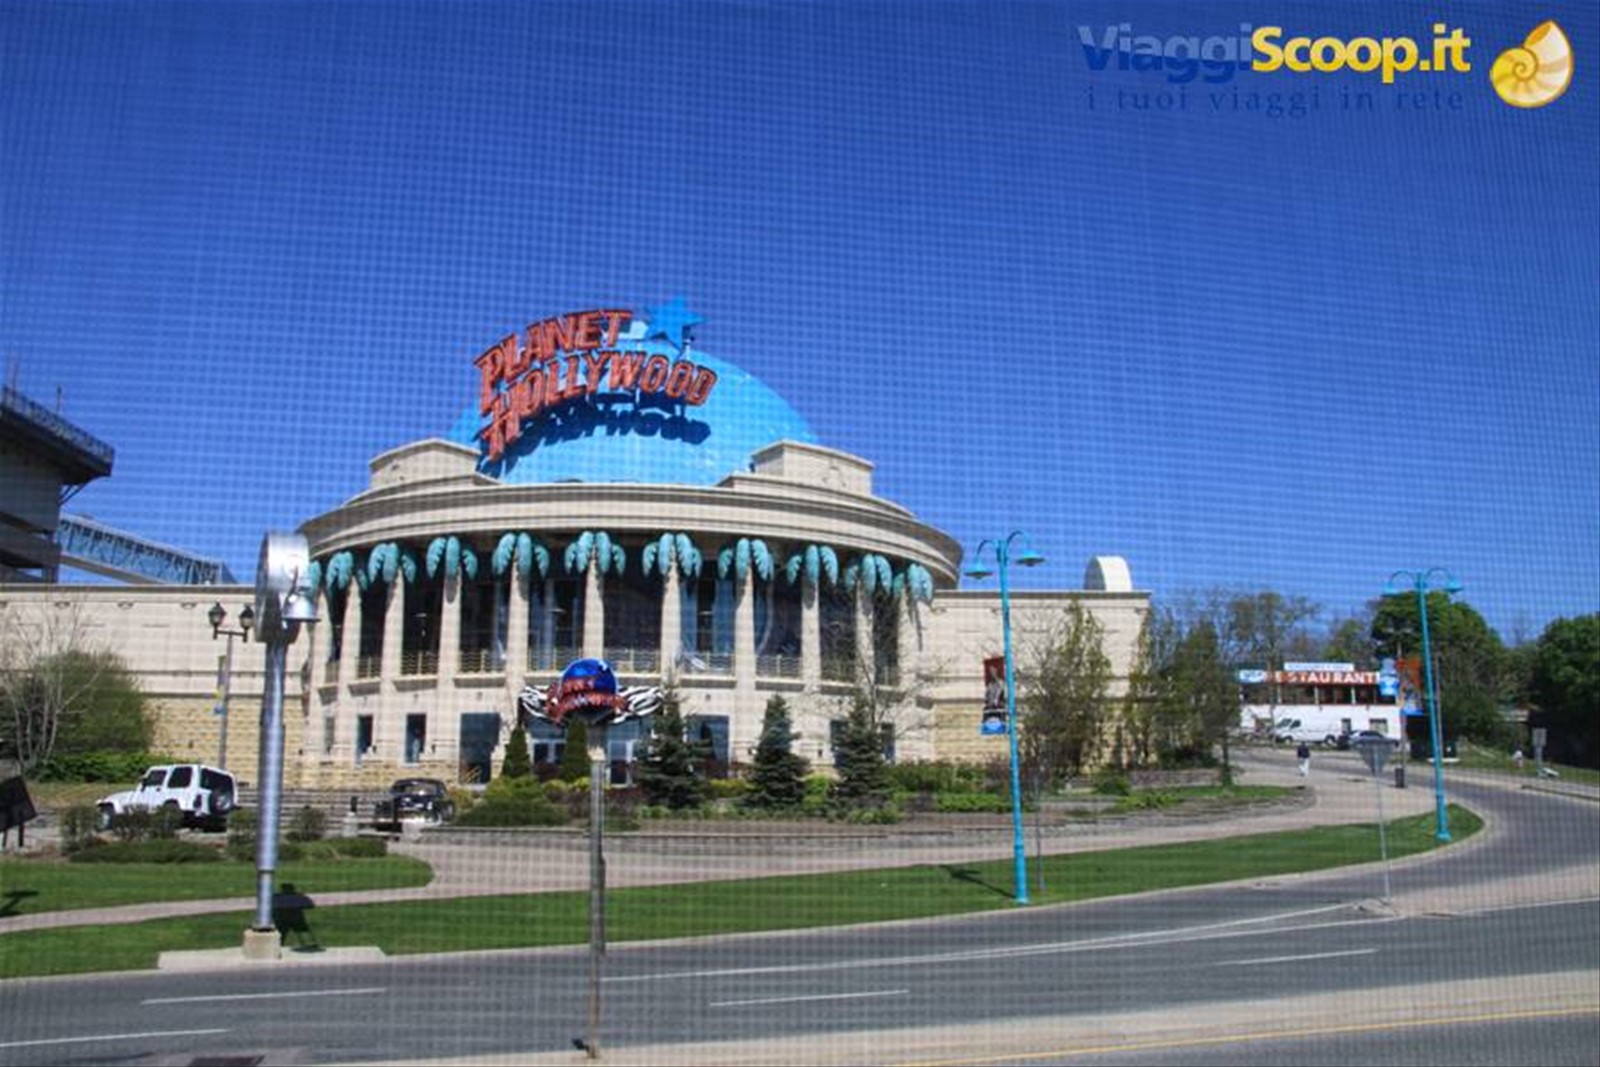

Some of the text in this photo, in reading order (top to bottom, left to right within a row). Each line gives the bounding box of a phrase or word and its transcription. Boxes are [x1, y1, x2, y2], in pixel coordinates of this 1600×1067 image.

[474, 309, 632, 416] PLANET
[480, 350, 718, 462] HOLLYWOOD
[1264, 670, 1376, 685] ESTAURANT
